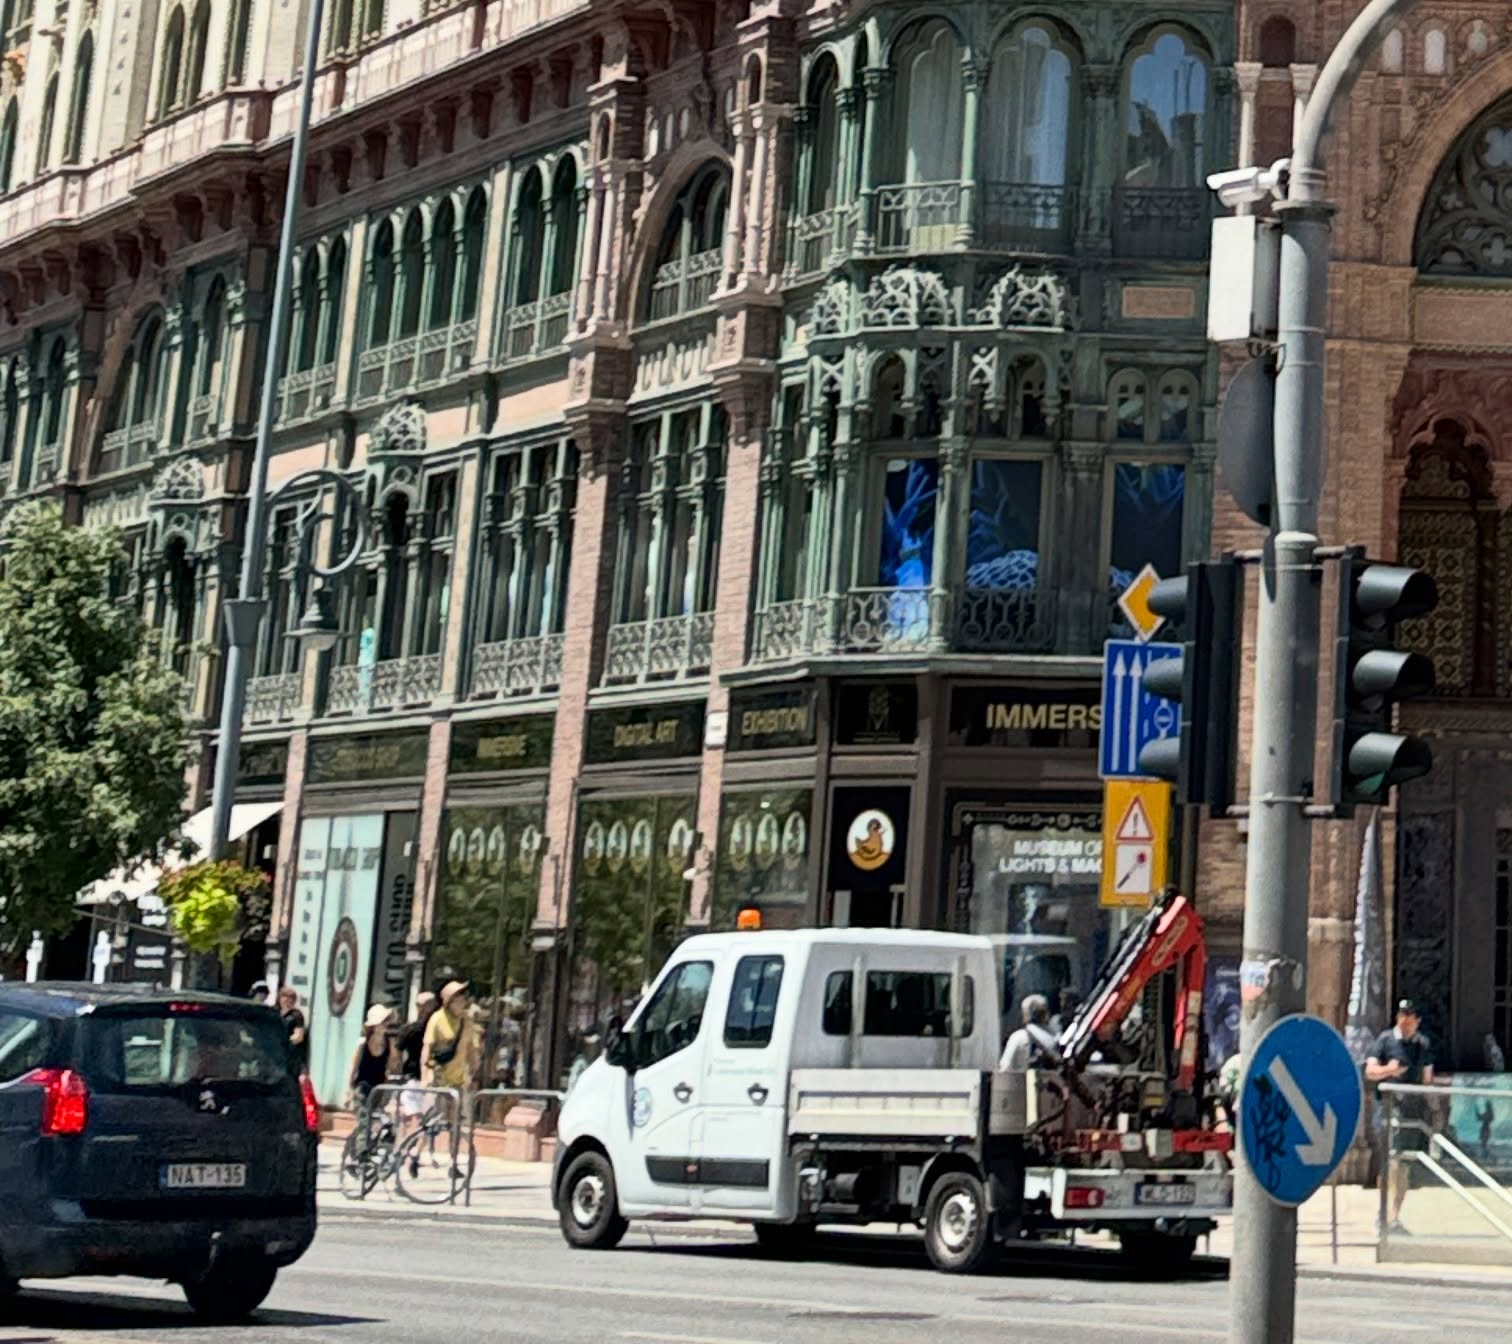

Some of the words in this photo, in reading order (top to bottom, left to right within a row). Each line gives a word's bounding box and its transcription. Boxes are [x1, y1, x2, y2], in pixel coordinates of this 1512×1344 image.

[742, 706, 808, 736] EXHIBITION
[1013, 840, 1082, 856] MUSEUM
[999, 857, 1055, 873] LIGHTS
